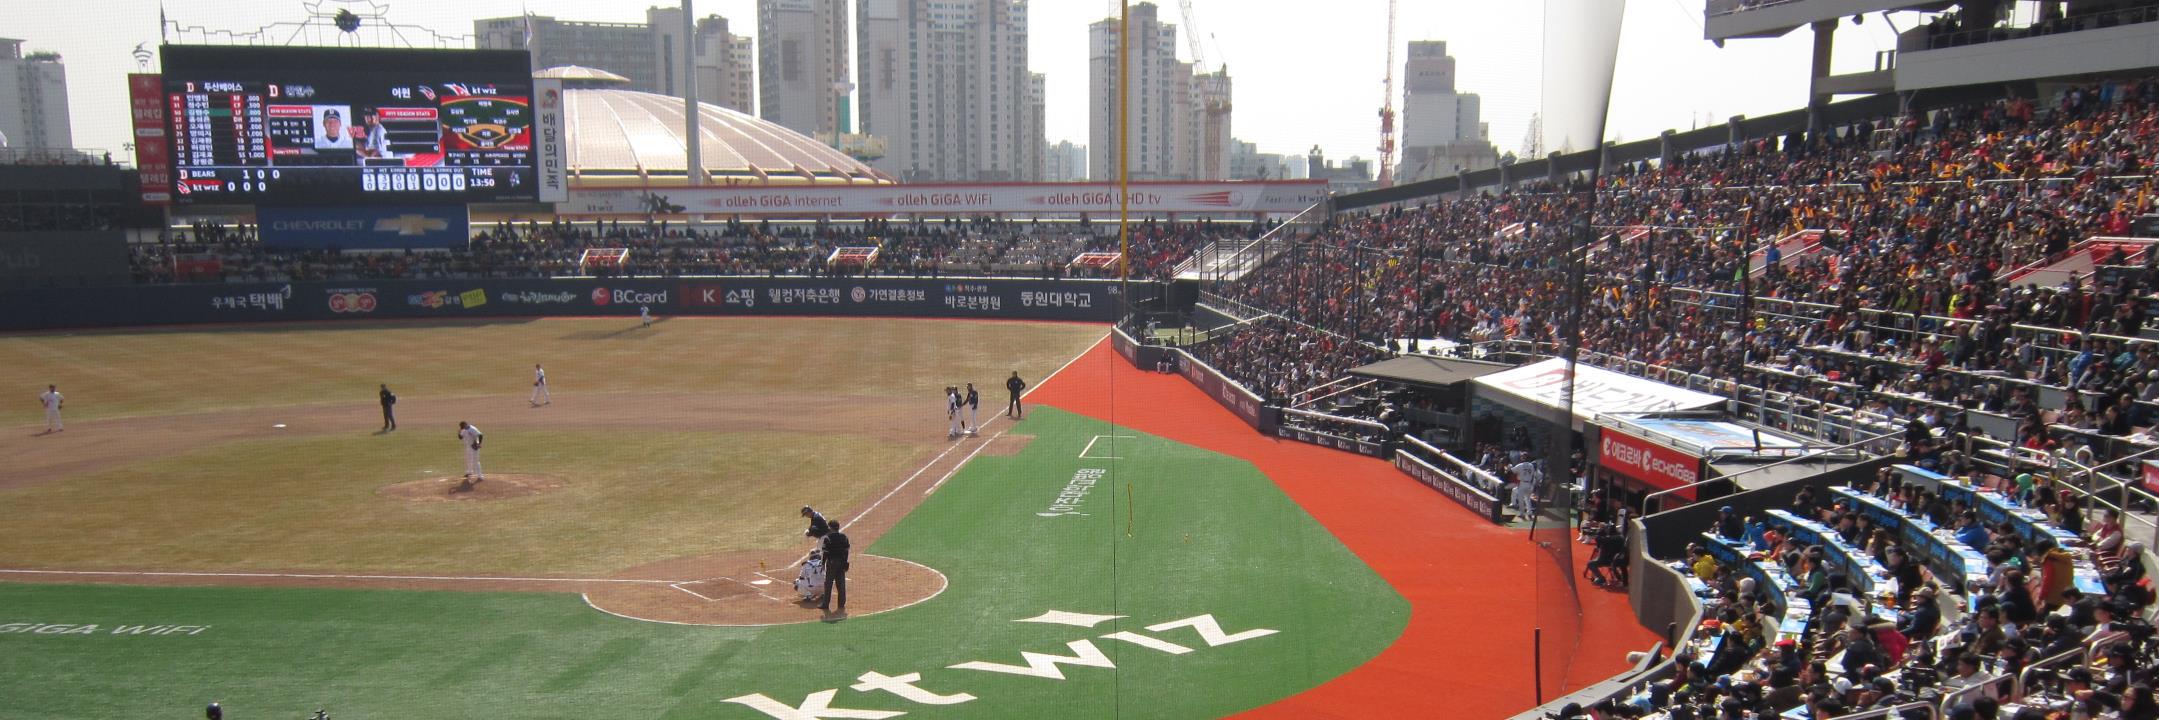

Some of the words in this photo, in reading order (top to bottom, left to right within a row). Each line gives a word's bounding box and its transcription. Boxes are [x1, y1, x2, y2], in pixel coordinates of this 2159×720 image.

[204, 82, 243, 92] 두산베어스
[542, 112, 559, 190] 배달의민족
[470, 178, 495, 187] 13:50
[726, 196, 757, 207] olleh
[795, 196, 841, 206] internet
[897, 193, 928, 205] olleh
[965, 194, 992, 205] WiFi
[1048, 193, 1078, 205] olleh
[1149, 193, 1161, 204] tv
[273, 220, 365, 230] CHEVROLET
[250, 292, 283, 310] 택배
[614, 289, 667, 304] BCcard
[726, 288, 755, 307] 쇼핑
[768, 288, 840, 304] 웰컴저축은행
[870, 288, 925, 302] 가연결혼정보
[1020, 291, 1091, 308] 동원대학교
[945, 295, 1000, 310] 바로본병원
[111, 624, 212, 635] WiFi
[720, 670, 978, 720] kt
[946, 610, 1280, 680] wiz
